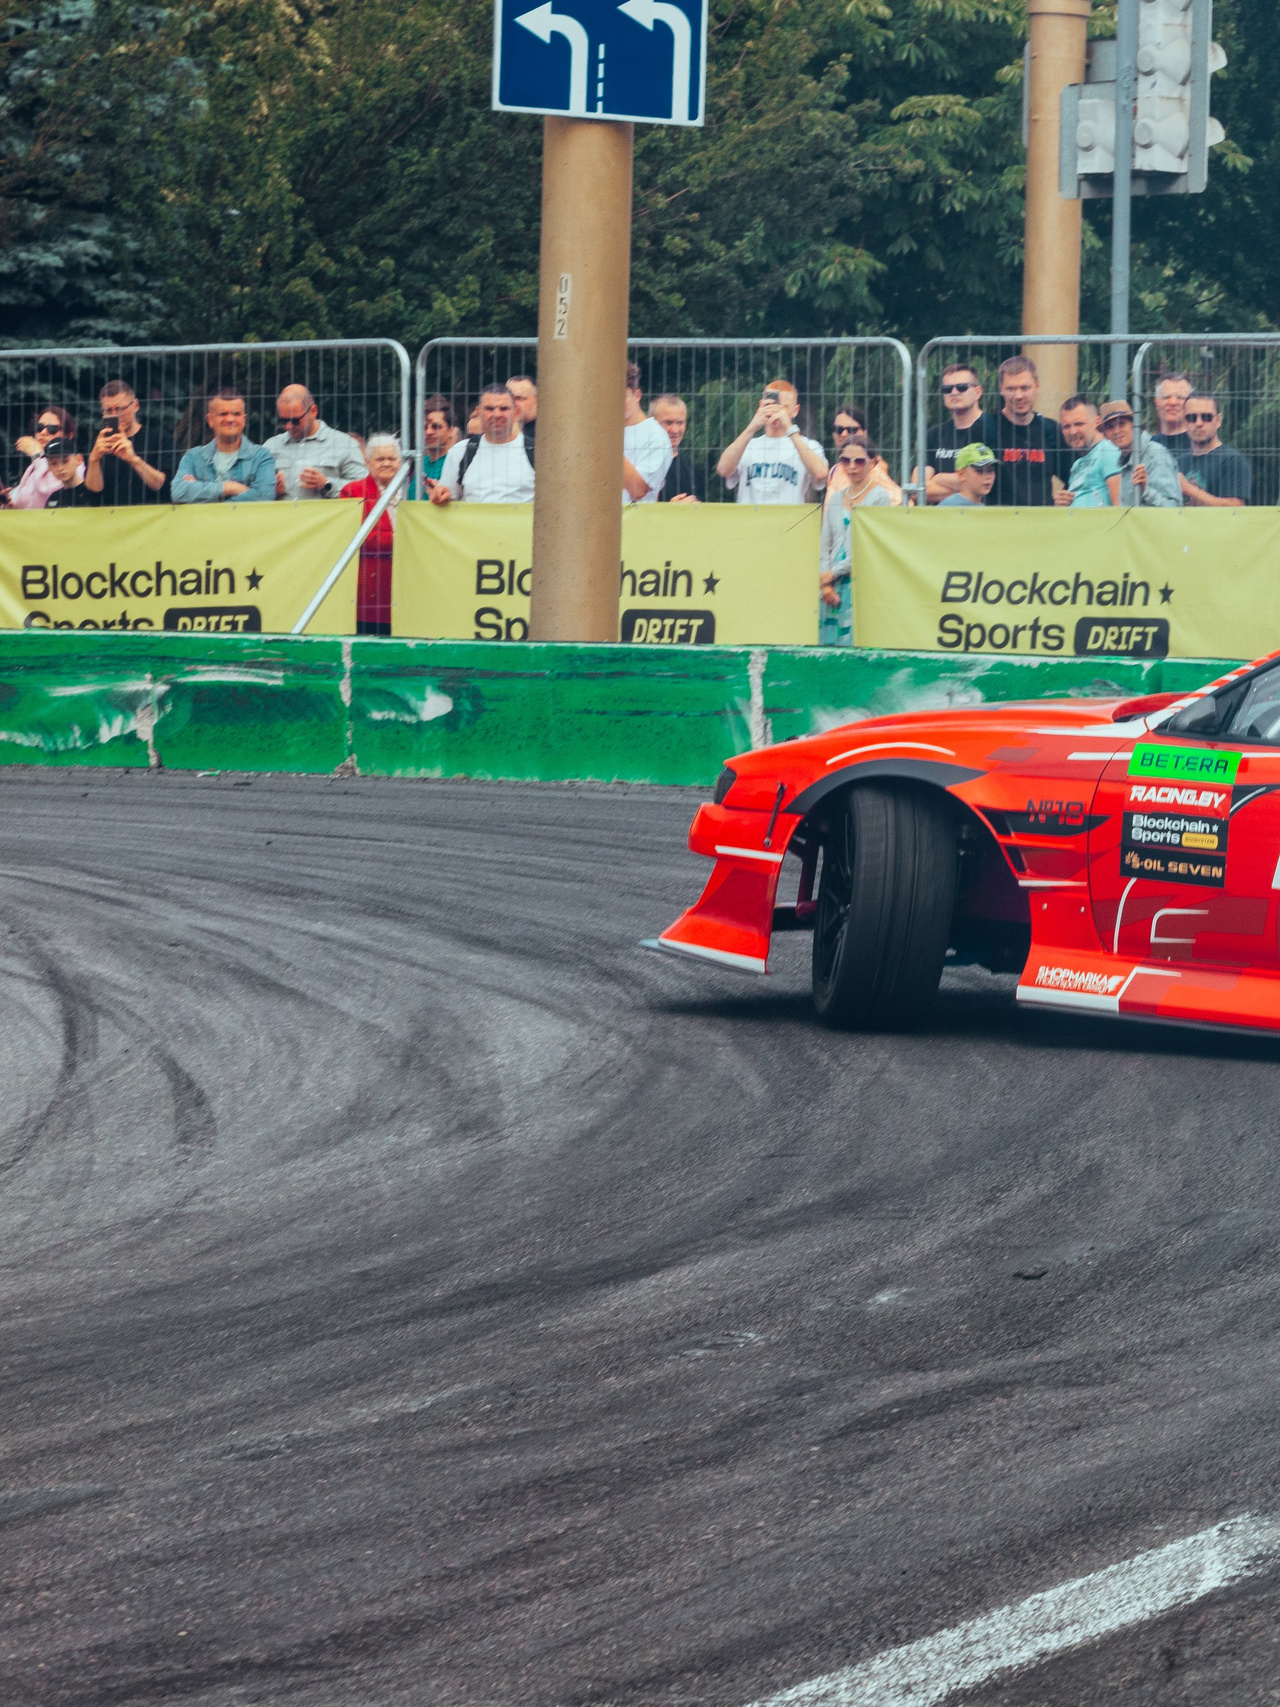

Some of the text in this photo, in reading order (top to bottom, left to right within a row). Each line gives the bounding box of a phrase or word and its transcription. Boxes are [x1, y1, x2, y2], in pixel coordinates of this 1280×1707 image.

[21, 559, 236, 600] Blockchain
[475, 559, 693, 597] Blohain
[940, 571, 1150, 606] Blockchain
[631, 618, 705, 643] DRIFT
[937, 613, 1159, 652] Sports DRIFT
[1129, 785, 1227, 809] RACING.BY
[1131, 827, 1180, 844] Sports
[1132, 814, 1210, 834] Blockchain
[1167, 861, 1223, 878] SEVEN
[1037, 965, 1108, 986] SHOPMARKA
